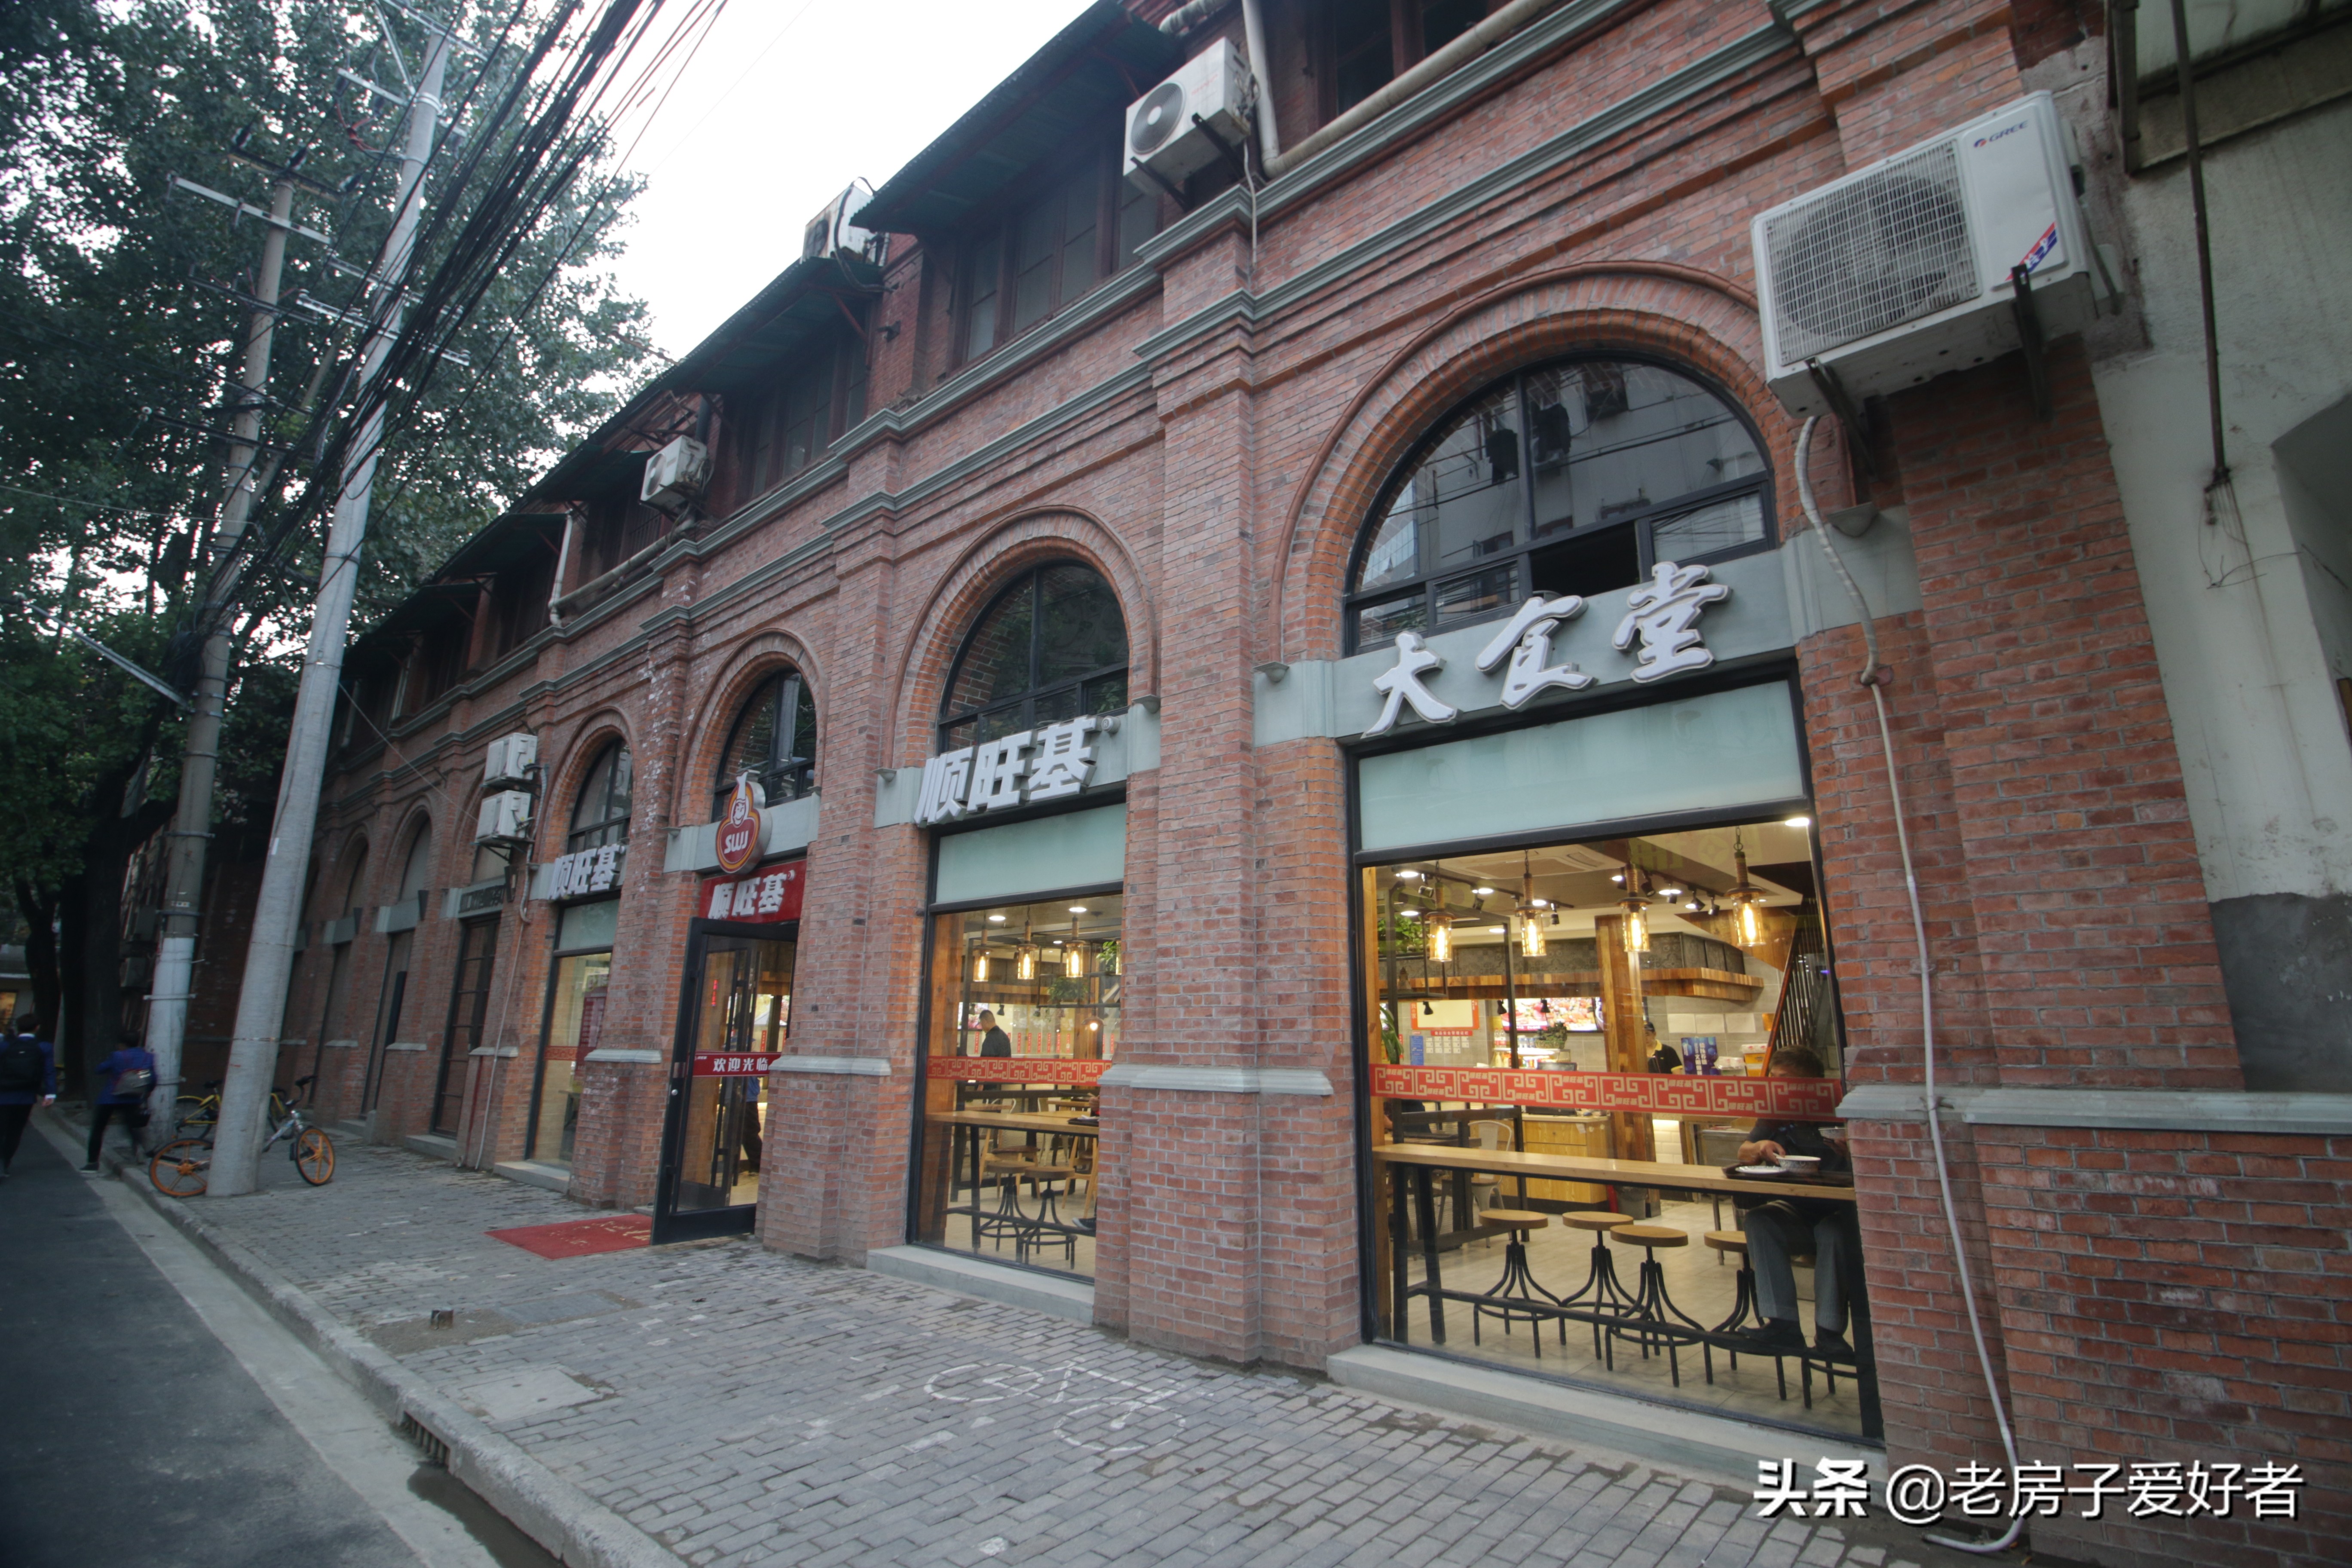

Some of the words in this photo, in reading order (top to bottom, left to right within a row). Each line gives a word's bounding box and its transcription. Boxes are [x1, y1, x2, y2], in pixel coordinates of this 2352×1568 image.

[1989, 119, 2029, 142] GREE
[1361, 561, 1731, 739] 大食堂
[914, 714, 1100, 827] 顺旺基
[547, 843, 620, 900] 顺旺基
[707, 873, 787, 920] 顺旺基
[713, 1057, 769, 1072] 欢迎光临
